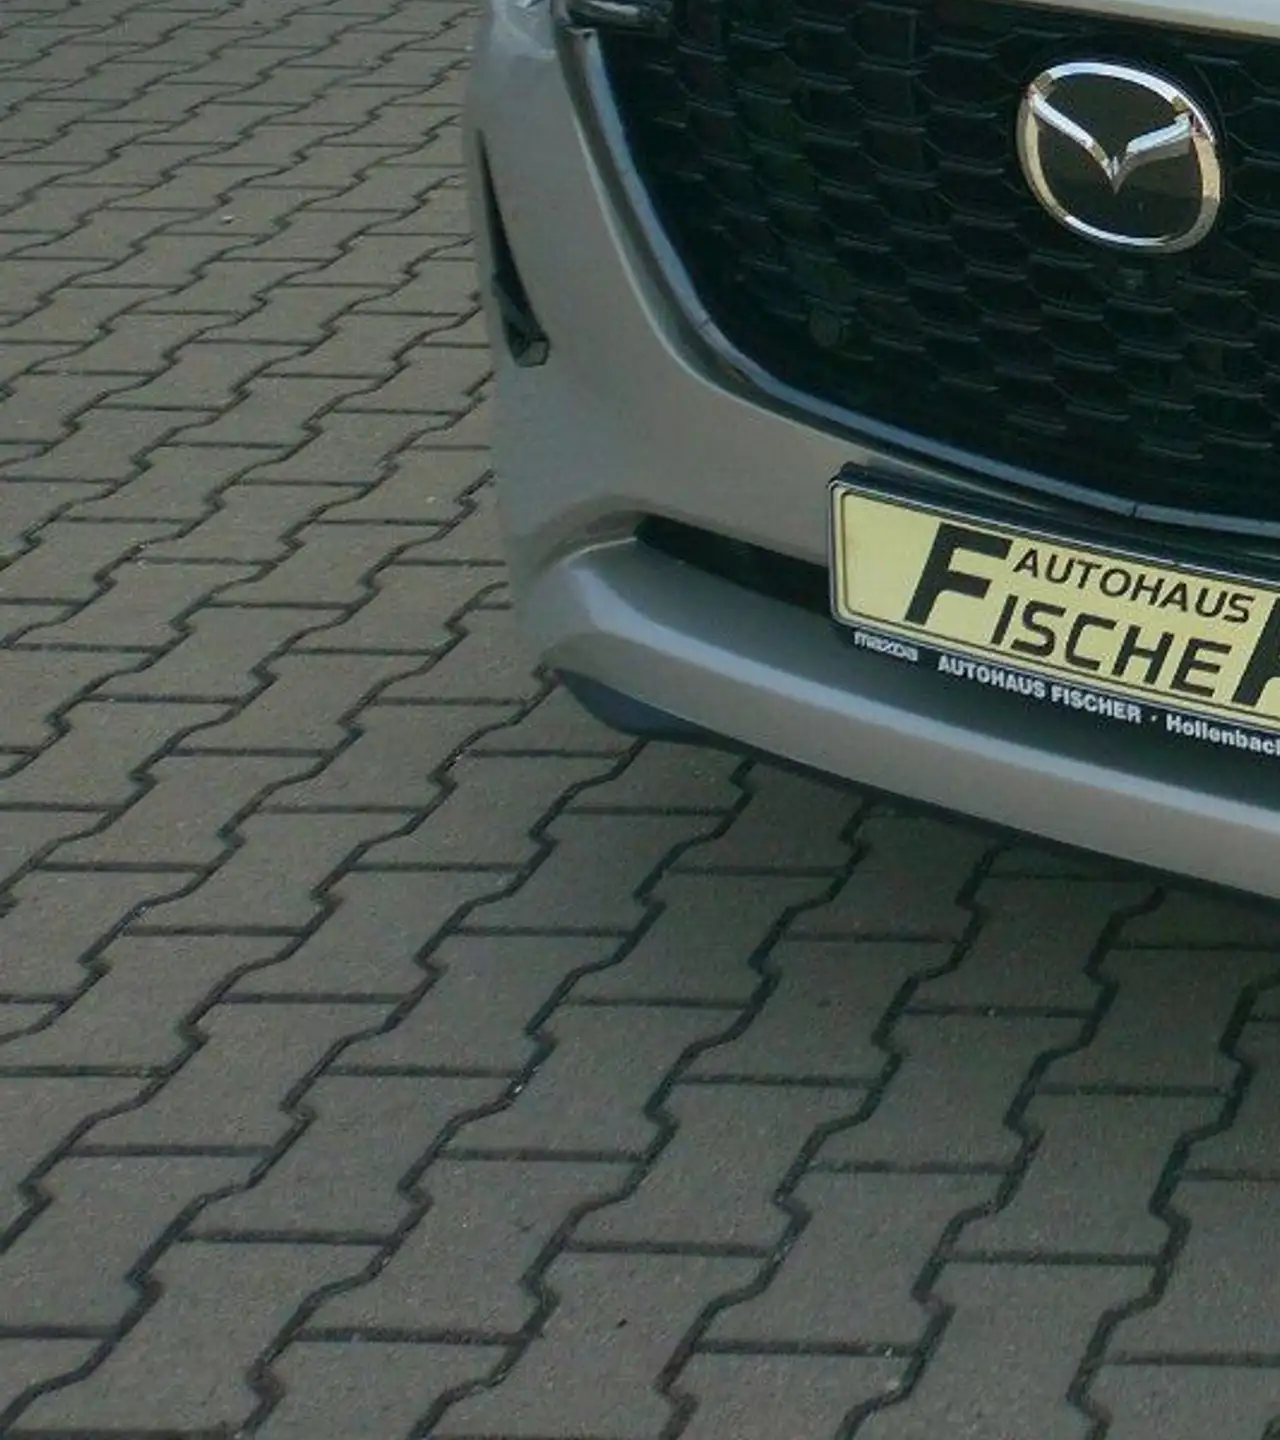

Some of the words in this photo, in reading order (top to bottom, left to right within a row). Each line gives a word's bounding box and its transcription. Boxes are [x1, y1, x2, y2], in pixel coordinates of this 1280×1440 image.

[1013, 548, 1255, 624] AUTOHAUS
[937, 655, 1046, 698] AUTOHAUS
[1051, 686, 1142, 723] FISCHER
